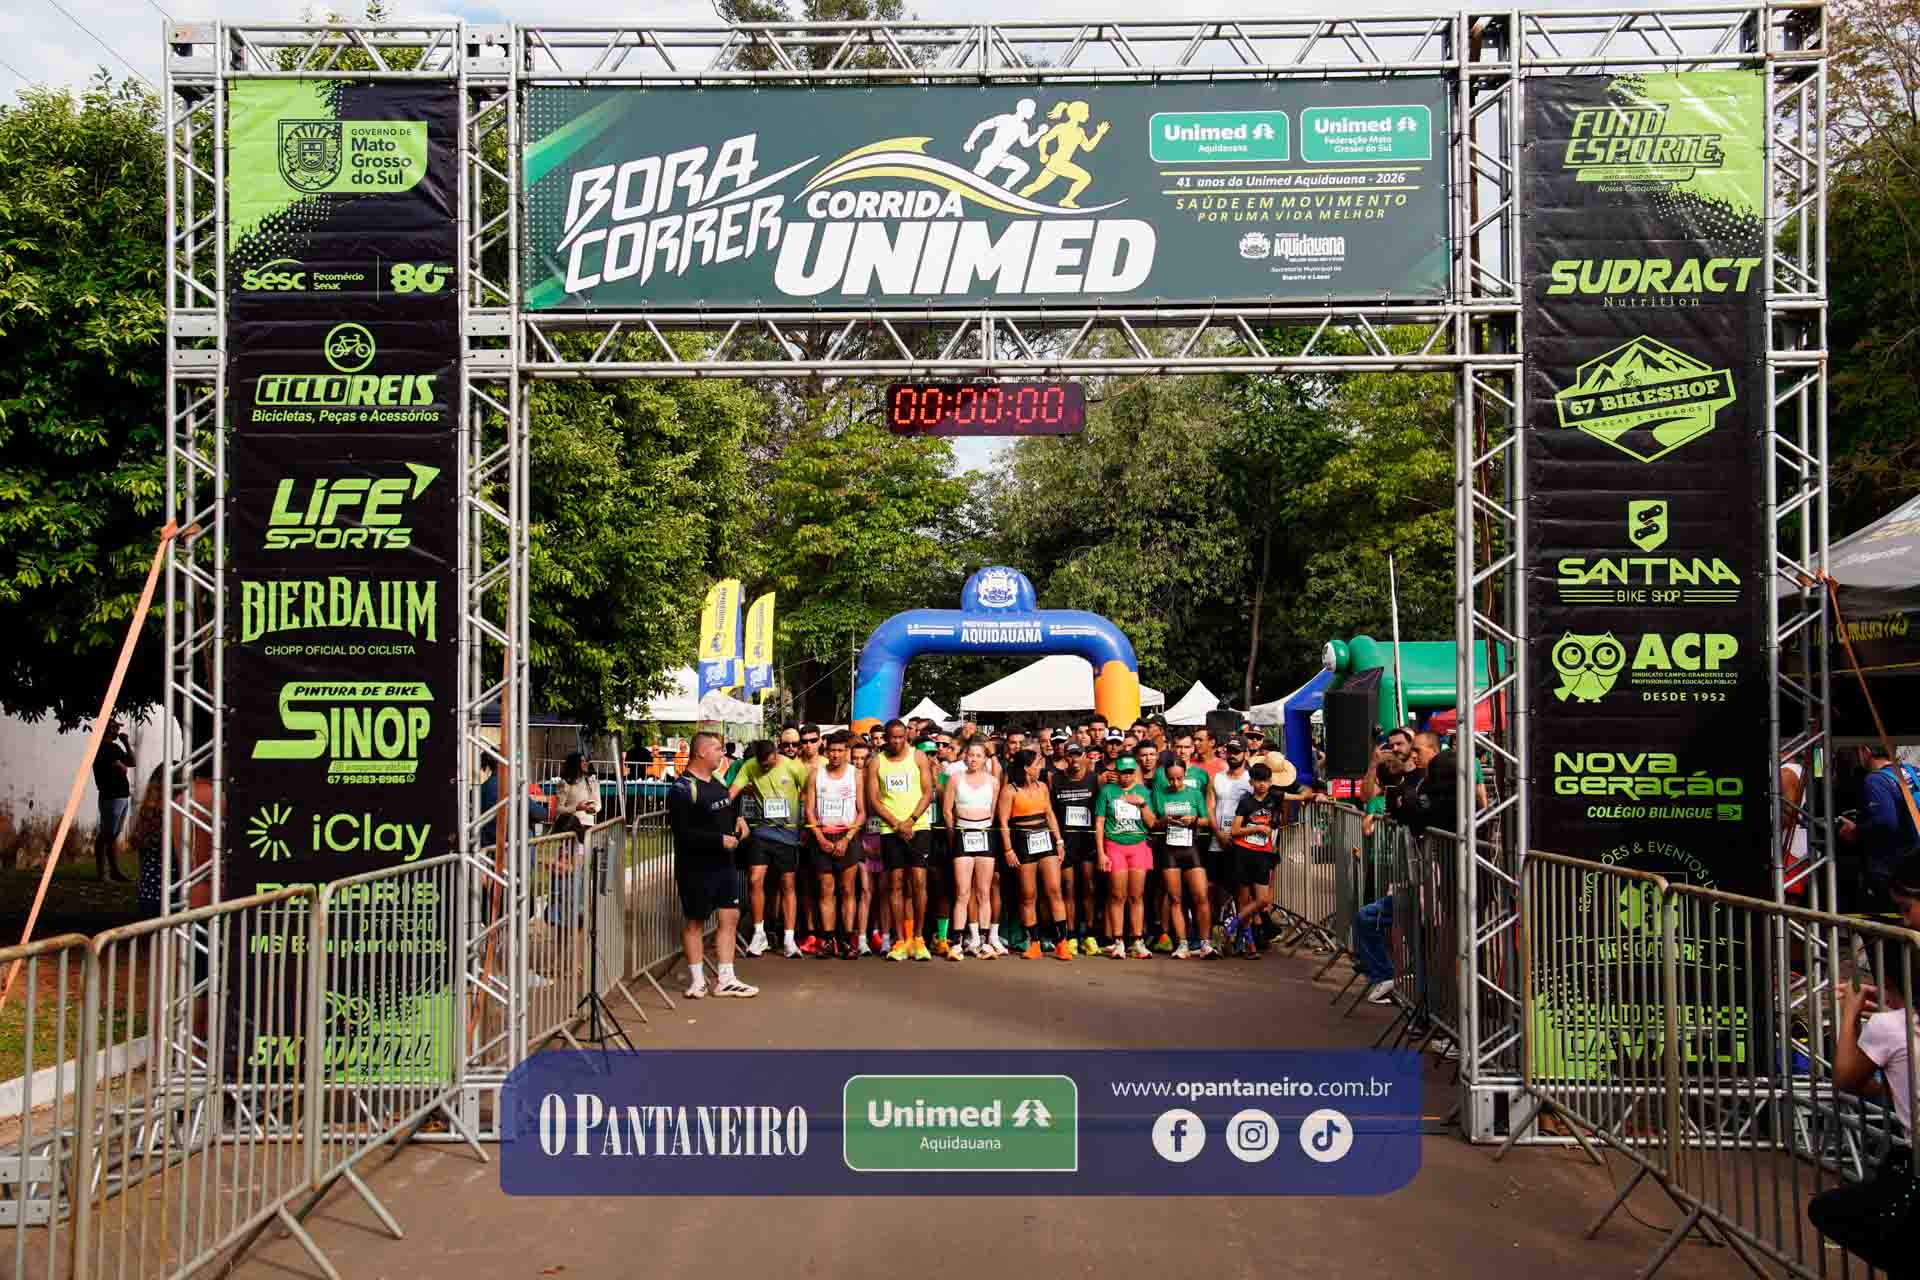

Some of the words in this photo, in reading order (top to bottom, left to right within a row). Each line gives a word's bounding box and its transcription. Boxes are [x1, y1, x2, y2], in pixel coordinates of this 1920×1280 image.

[351, 128, 397, 136] GOVERNO
[399, 128, 412, 136] DE
[1164, 123, 1248, 141] Unimed
[1314, 116, 1392, 135] Unimed
[351, 137, 396, 152] Mato
[1564, 136, 1721, 164] ESPORTE
[351, 154, 413, 168] Grosso
[351, 170, 374, 185] do
[377, 170, 404, 185] Sul
[1176, 175, 1191, 188] 41
[1197, 177, 1225, 188] anos
[1246, 174, 1292, 187] Unimed
[1294, 174, 1367, 188] Aquidauana
[1376, 173, 1406, 185] 2026
[556, 133, 759, 252] BORA
[807, 191, 964, 219] CORRIDA
[1176, 195, 1241, 210] SAÚDE
[1247, 196, 1274, 209] EM
[1281, 194, 1408, 209] MOVIMENTO
[1198, 210, 1229, 222] POR
[1234, 210, 1269, 222] UMA
[1275, 209, 1314, 221] VIDA
[1319, 209, 1386, 220] MELHOR
[565, 194, 785, 294] CORRER
[774, 219, 1156, 296] UNIMED
[1547, 257, 1762, 295] SUDRACT
[1603, 296, 1700, 308] Nutrition
[894, 387, 1066, 425] 00:00:00
[1569, 398, 1596, 416] 67
[1600, 378, 1722, 412] BIKESHOP
[252, 409, 317, 424] Bicicletas,
[319, 409, 357, 425] Peças
[359, 412, 368, 423] e
[369, 409, 440, 424] Acessórios
[263, 528, 414, 550] SPORTS
[1558, 558, 1741, 585] SANTANA
[1617, 590, 1646, 603] BIKE
[1651, 590, 1681, 603] SHOP
[241, 576, 438, 644] BIERBAUM
[961, 628, 1043, 644] AQUIDAUANA
[264, 645, 303, 656] CHOPP
[305, 645, 347, 656] OFICIAL
[349, 645, 366, 656] DO
[367, 645, 416, 656] CICLISTA
[1632, 632, 1739, 671] ACP
[294, 686, 357, 697] PINTURA
[361, 686, 379, 697] DE
[384, 686, 420, 697] BIKE
[1643, 691, 1687, 702] DESDE
[1692, 691, 1726, 702] 1952
[252, 682, 432, 760] SINOP
[327, 775, 341, 785] 67
[1587, 804, 1645, 819] COLÉGIO
[312, 812, 432, 861] iClay
[1633, 841, 1643, 854] &
[1648, 840, 1708, 880] EVENTOS
